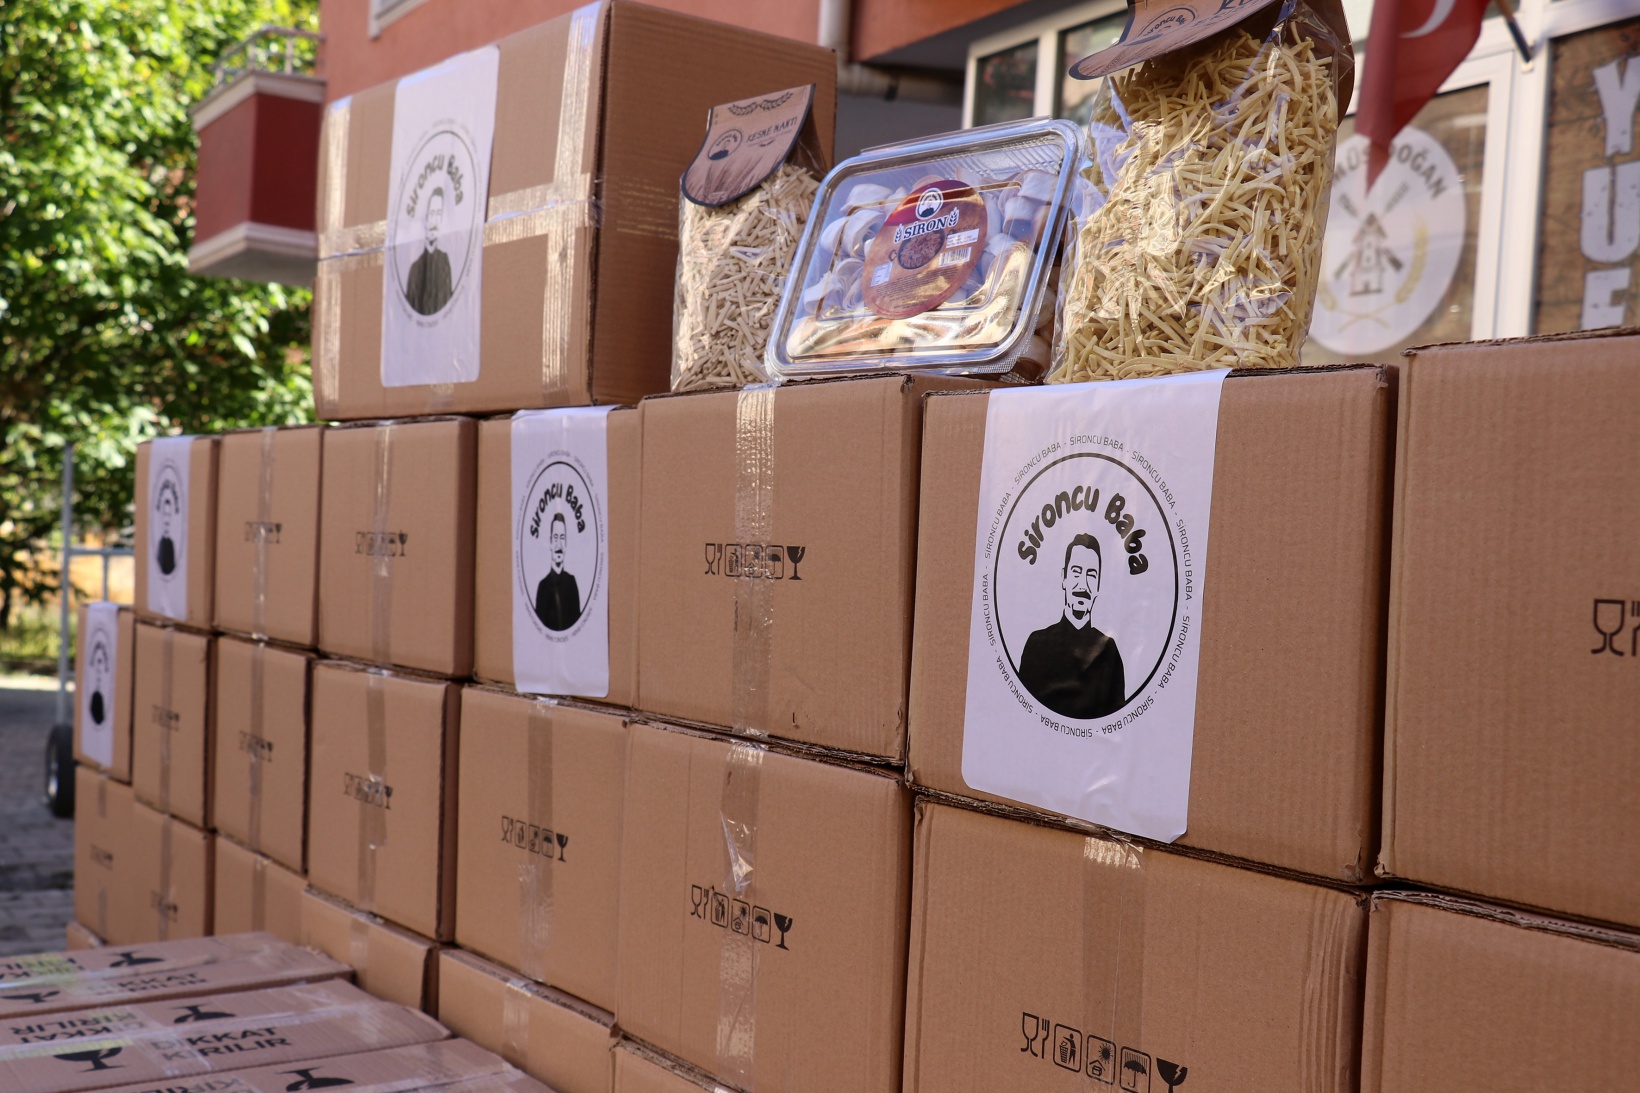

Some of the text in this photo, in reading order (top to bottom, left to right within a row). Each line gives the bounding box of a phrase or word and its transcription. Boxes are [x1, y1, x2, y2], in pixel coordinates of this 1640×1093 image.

[446, 154, 464, 206] Baba
[903, 215, 948, 240] SİRON
[529, 482, 586, 539] Sironcu Baba
[1017, 485, 1149, 576] Sironcu Baba
